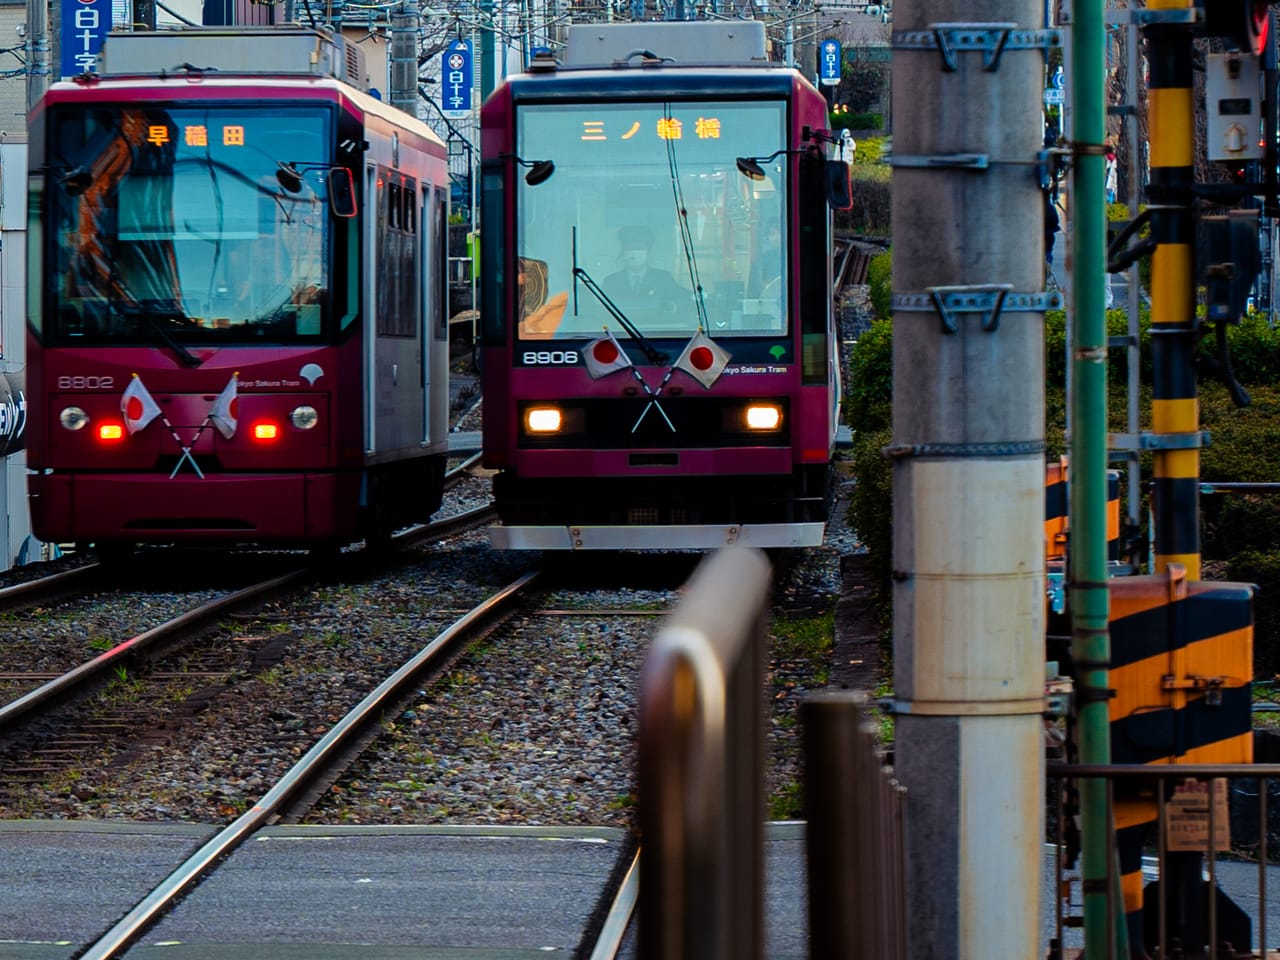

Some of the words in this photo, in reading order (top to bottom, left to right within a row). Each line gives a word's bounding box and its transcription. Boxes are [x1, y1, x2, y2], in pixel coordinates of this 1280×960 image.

[74, 6, 99, 73] 白十字
[449, 70, 464, 109] 白十字
[147, 125, 244, 147] 早稲田
[523, 351, 578, 364] 8906
[722, 366, 740, 375] okyo
[741, 365, 766, 374] Sakura
[767, 365, 787, 373] Tram
[58, 376, 114, 389] 8802
[236, 380, 253, 388] okyo
